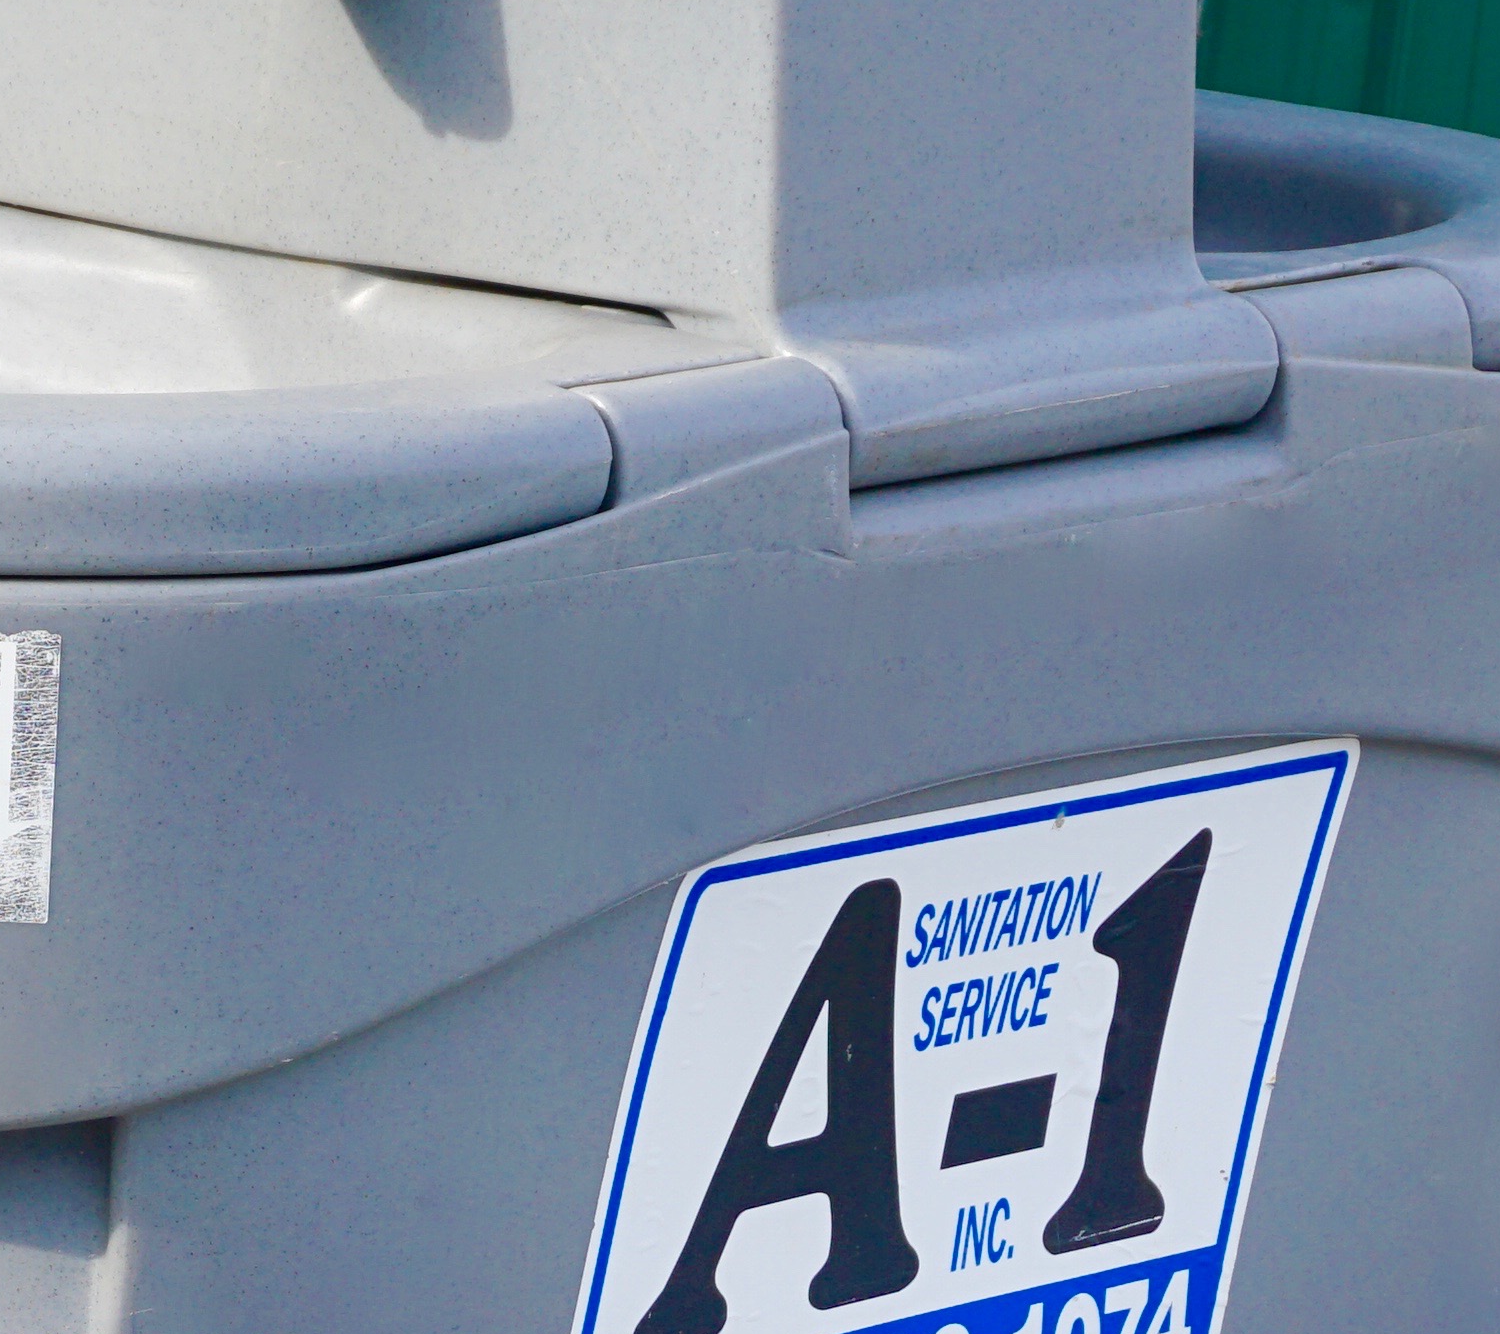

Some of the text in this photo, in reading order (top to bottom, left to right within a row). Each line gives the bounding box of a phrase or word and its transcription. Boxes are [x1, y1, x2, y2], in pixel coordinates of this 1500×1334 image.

[904, 872, 1103, 969] SANITATION
[911, 964, 1058, 1053] SERVICE
[950, 1199, 1015, 1272] INC.
